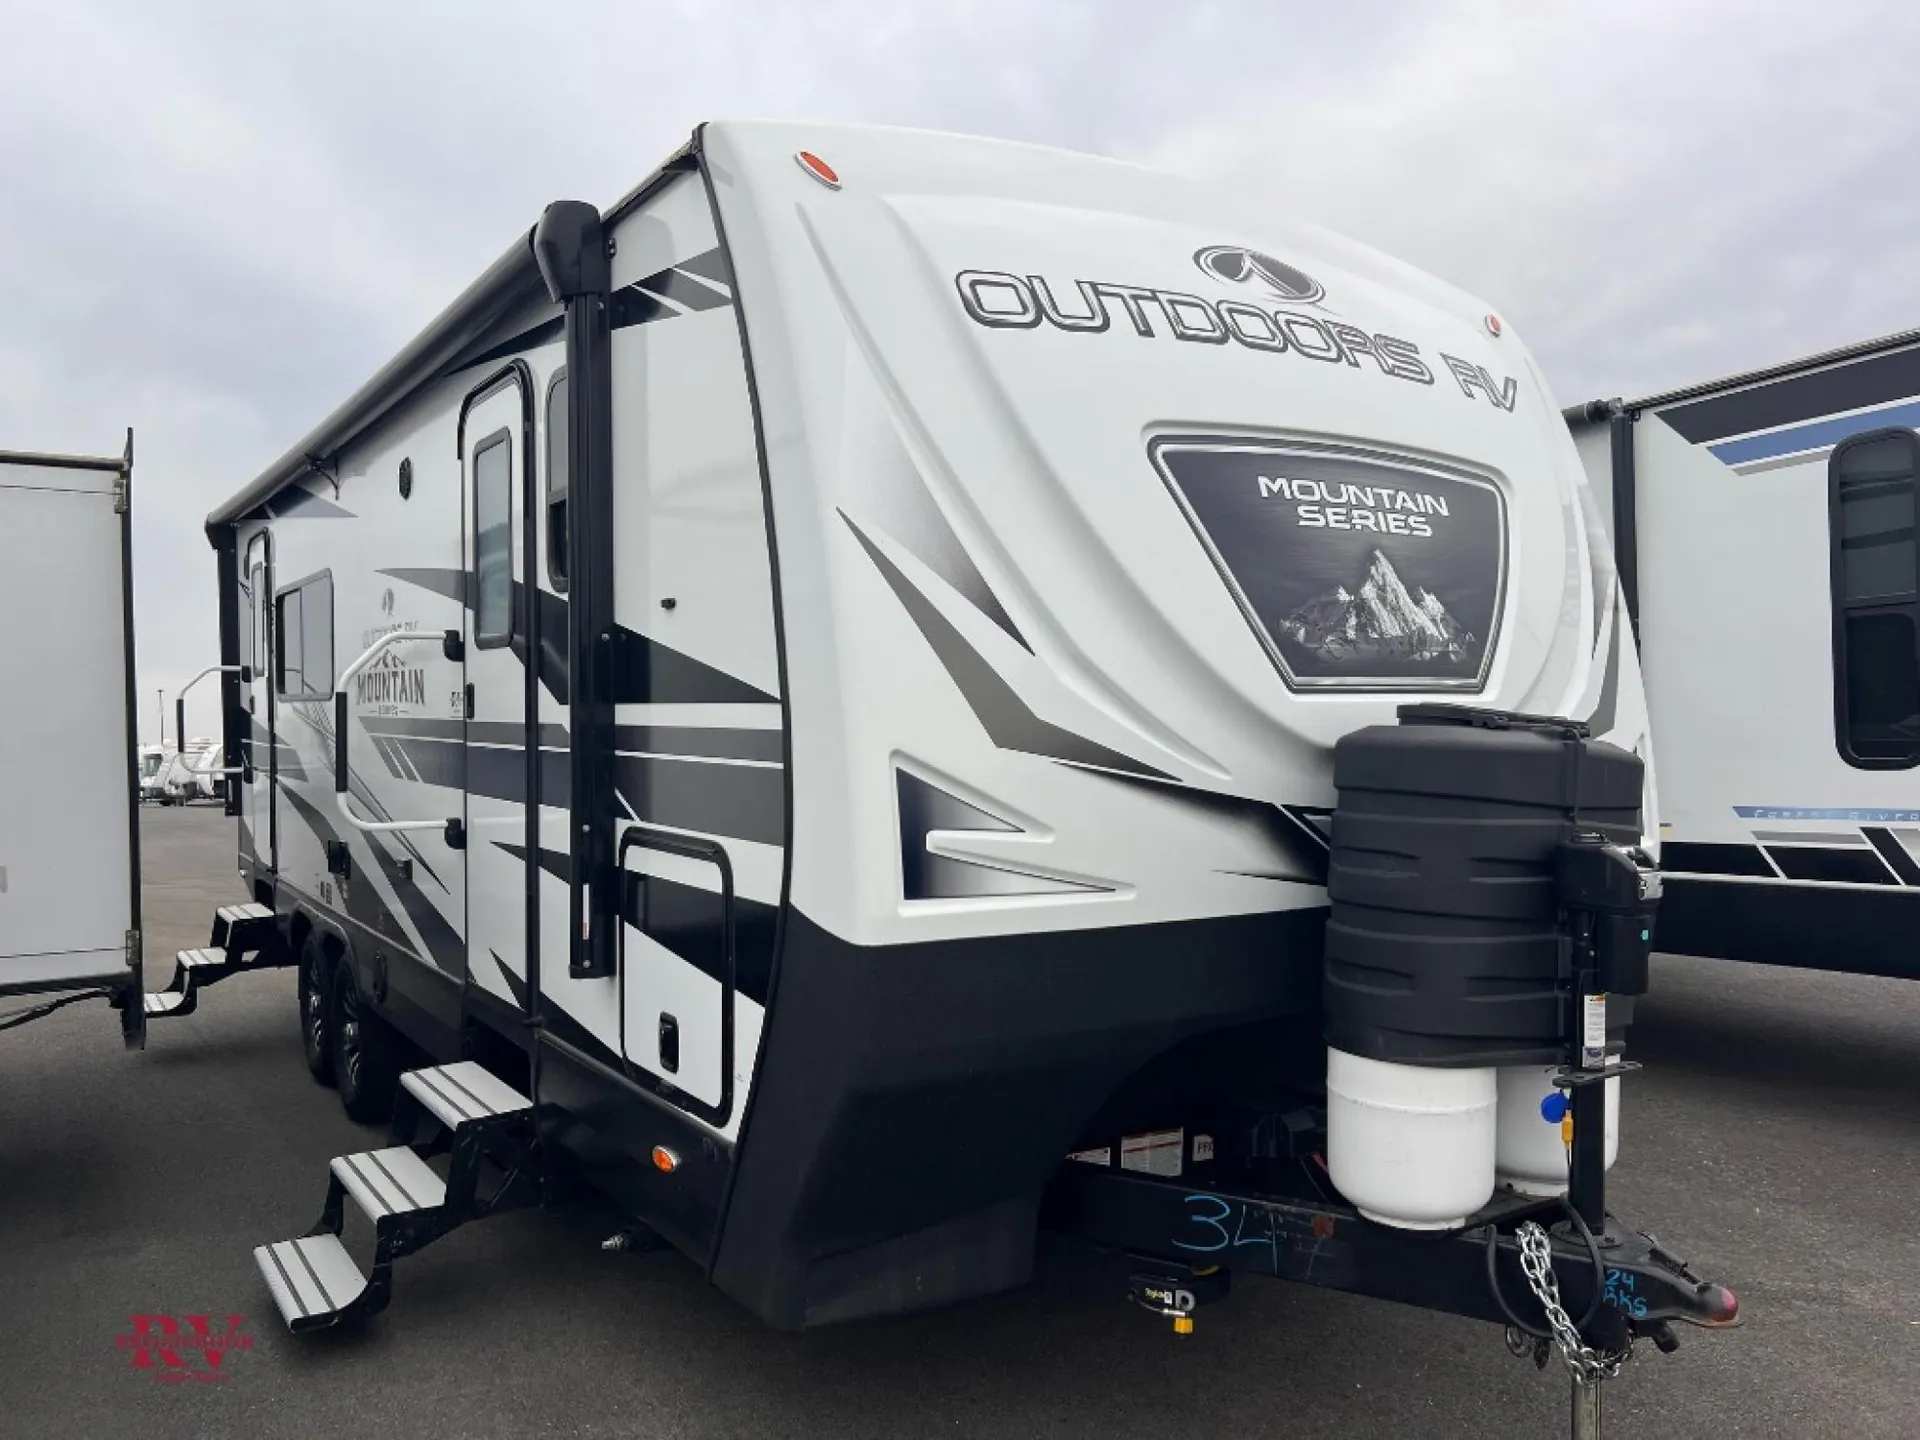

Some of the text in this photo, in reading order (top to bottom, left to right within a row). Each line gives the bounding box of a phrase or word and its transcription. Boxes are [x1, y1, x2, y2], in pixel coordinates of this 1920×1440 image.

[955, 269, 1517, 413] OUTDOORS RV
[1256, 475, 1450, 517] MOUNTAIN
[1296, 505, 1433, 537] SERIES
[356, 668, 426, 706] MOUNTAIN
[1604, 1268, 1635, 1294] 24
